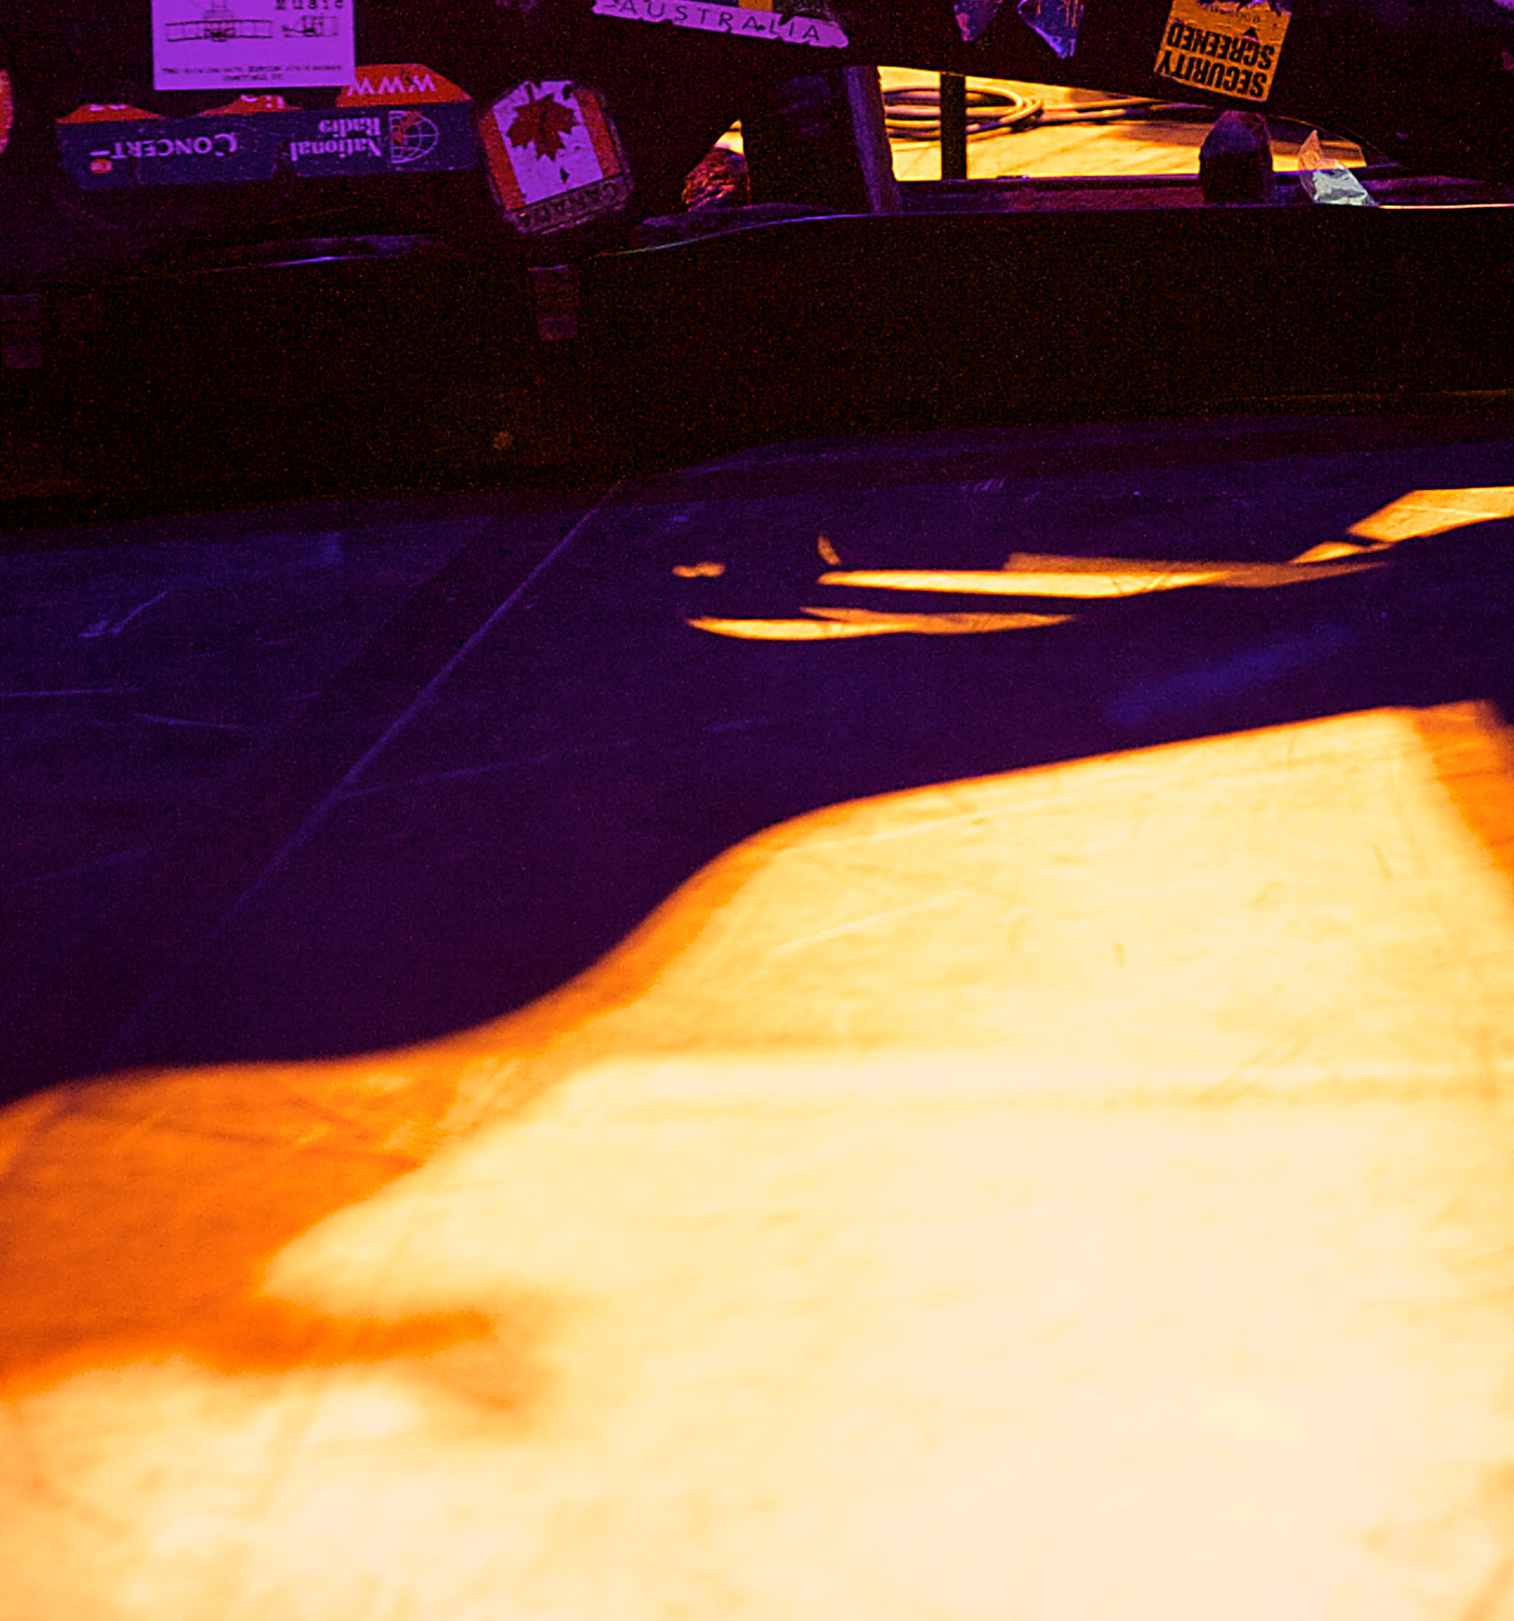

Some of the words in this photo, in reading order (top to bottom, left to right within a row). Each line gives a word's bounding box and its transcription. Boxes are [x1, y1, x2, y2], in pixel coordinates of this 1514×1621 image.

[1167, 23, 1274, 70] SCREENED
[1157, 50, 1267, 97] SECURITY
[114, 132, 238, 160] CONCERT
[289, 137, 382, 161] National
